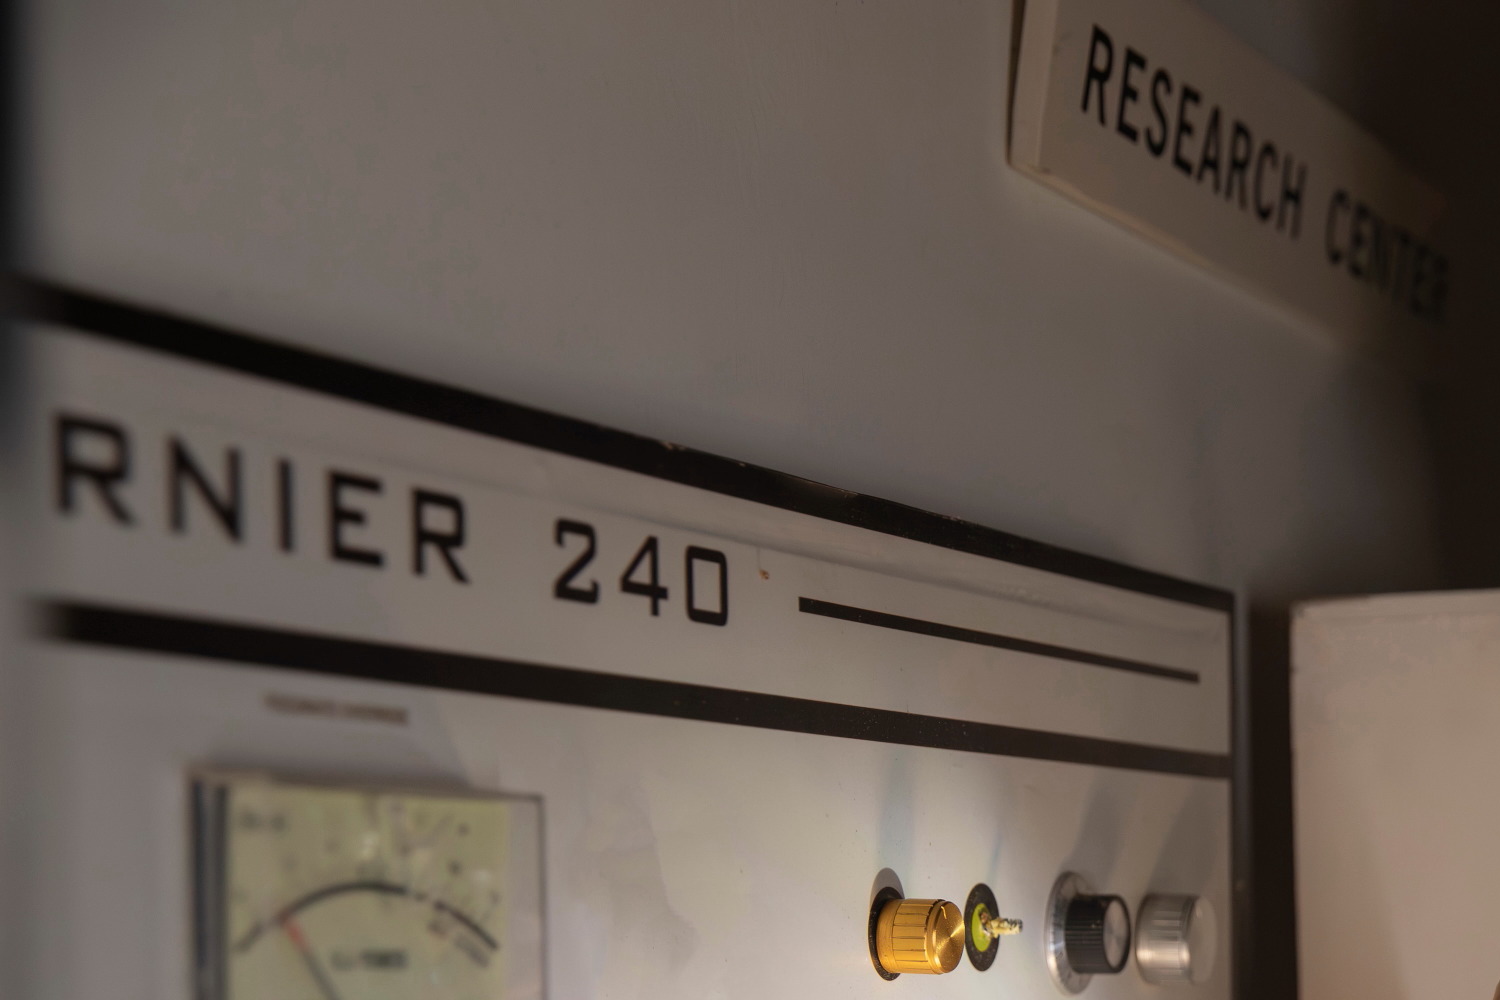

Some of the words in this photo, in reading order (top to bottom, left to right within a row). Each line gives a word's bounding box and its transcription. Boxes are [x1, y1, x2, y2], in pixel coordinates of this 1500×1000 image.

[1080, 22, 1308, 240] RESEARCH
[1325, 187, 1451, 327] CENTER
[54, 413, 471, 584] RNIER
[552, 517, 730, 627] 240
